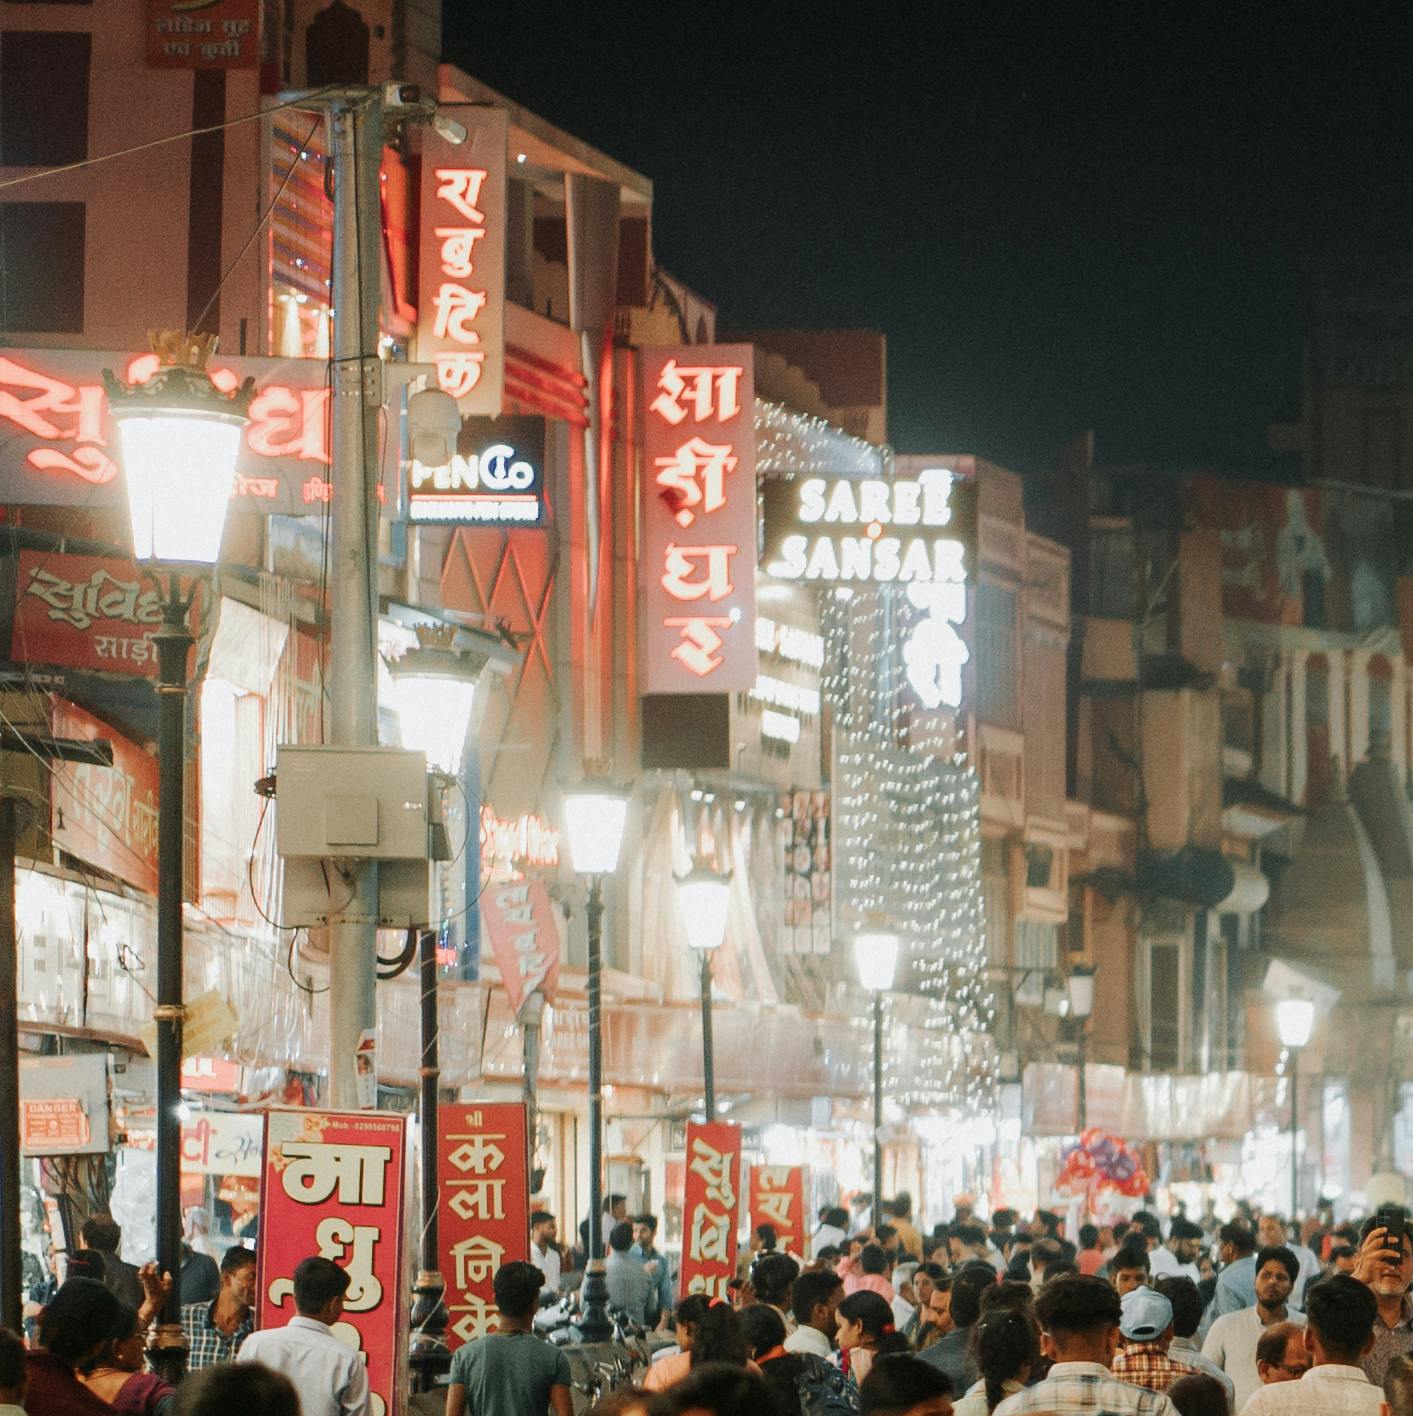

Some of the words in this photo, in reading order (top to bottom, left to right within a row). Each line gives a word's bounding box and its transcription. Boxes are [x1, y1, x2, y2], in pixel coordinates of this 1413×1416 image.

[798, 478, 952, 526] SAREE
[779, 535, 968, 582] SANSAR
[29, 1103, 77, 1113] DANGER
